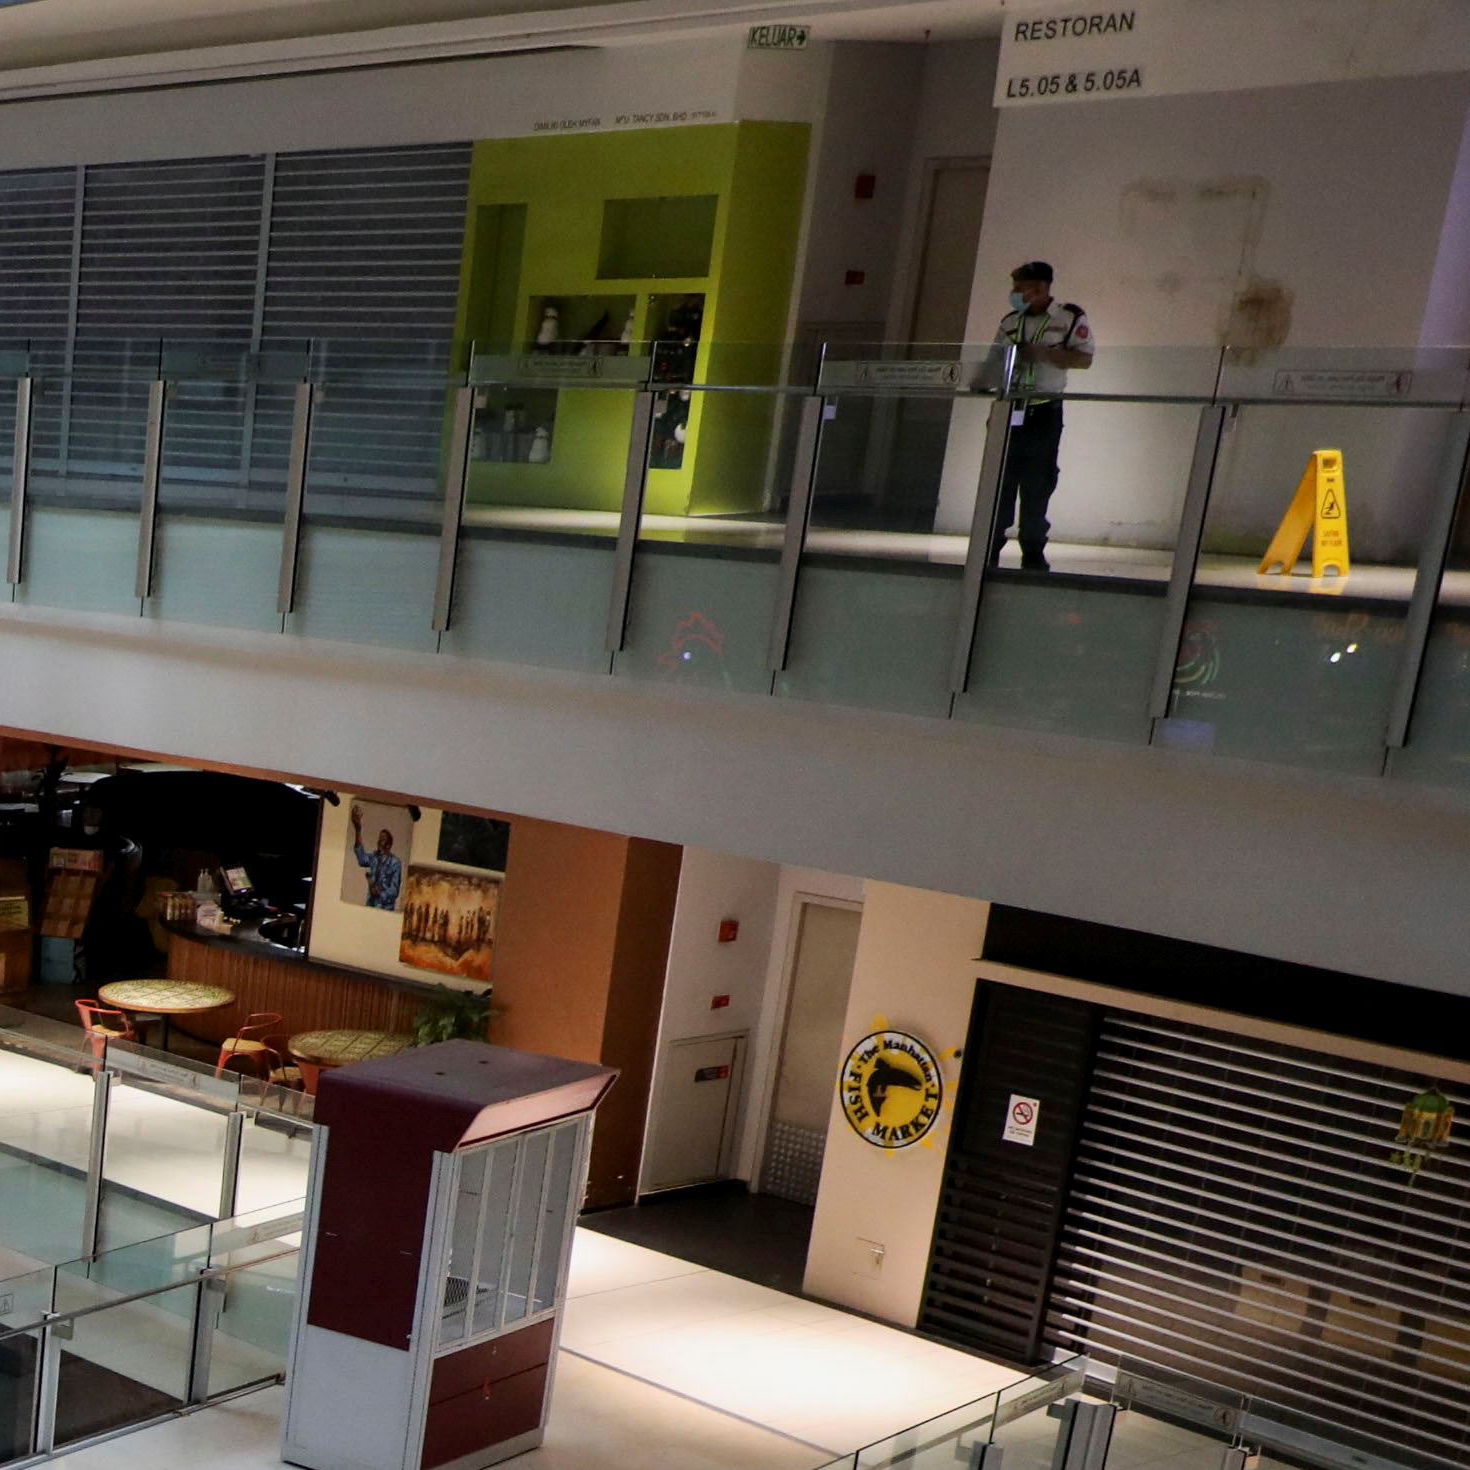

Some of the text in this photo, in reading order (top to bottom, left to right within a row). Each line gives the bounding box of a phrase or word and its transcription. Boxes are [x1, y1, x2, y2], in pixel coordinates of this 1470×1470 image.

[750, 25, 796, 48] KELUAR
[1014, 10, 1135, 42] RESTORAN
[1006, 68, 1142, 98] L5.05 & 5.05A
[858, 1039, 932, 1083] The Manhattan
[848, 1071, 938, 1141] FISH MARKET
